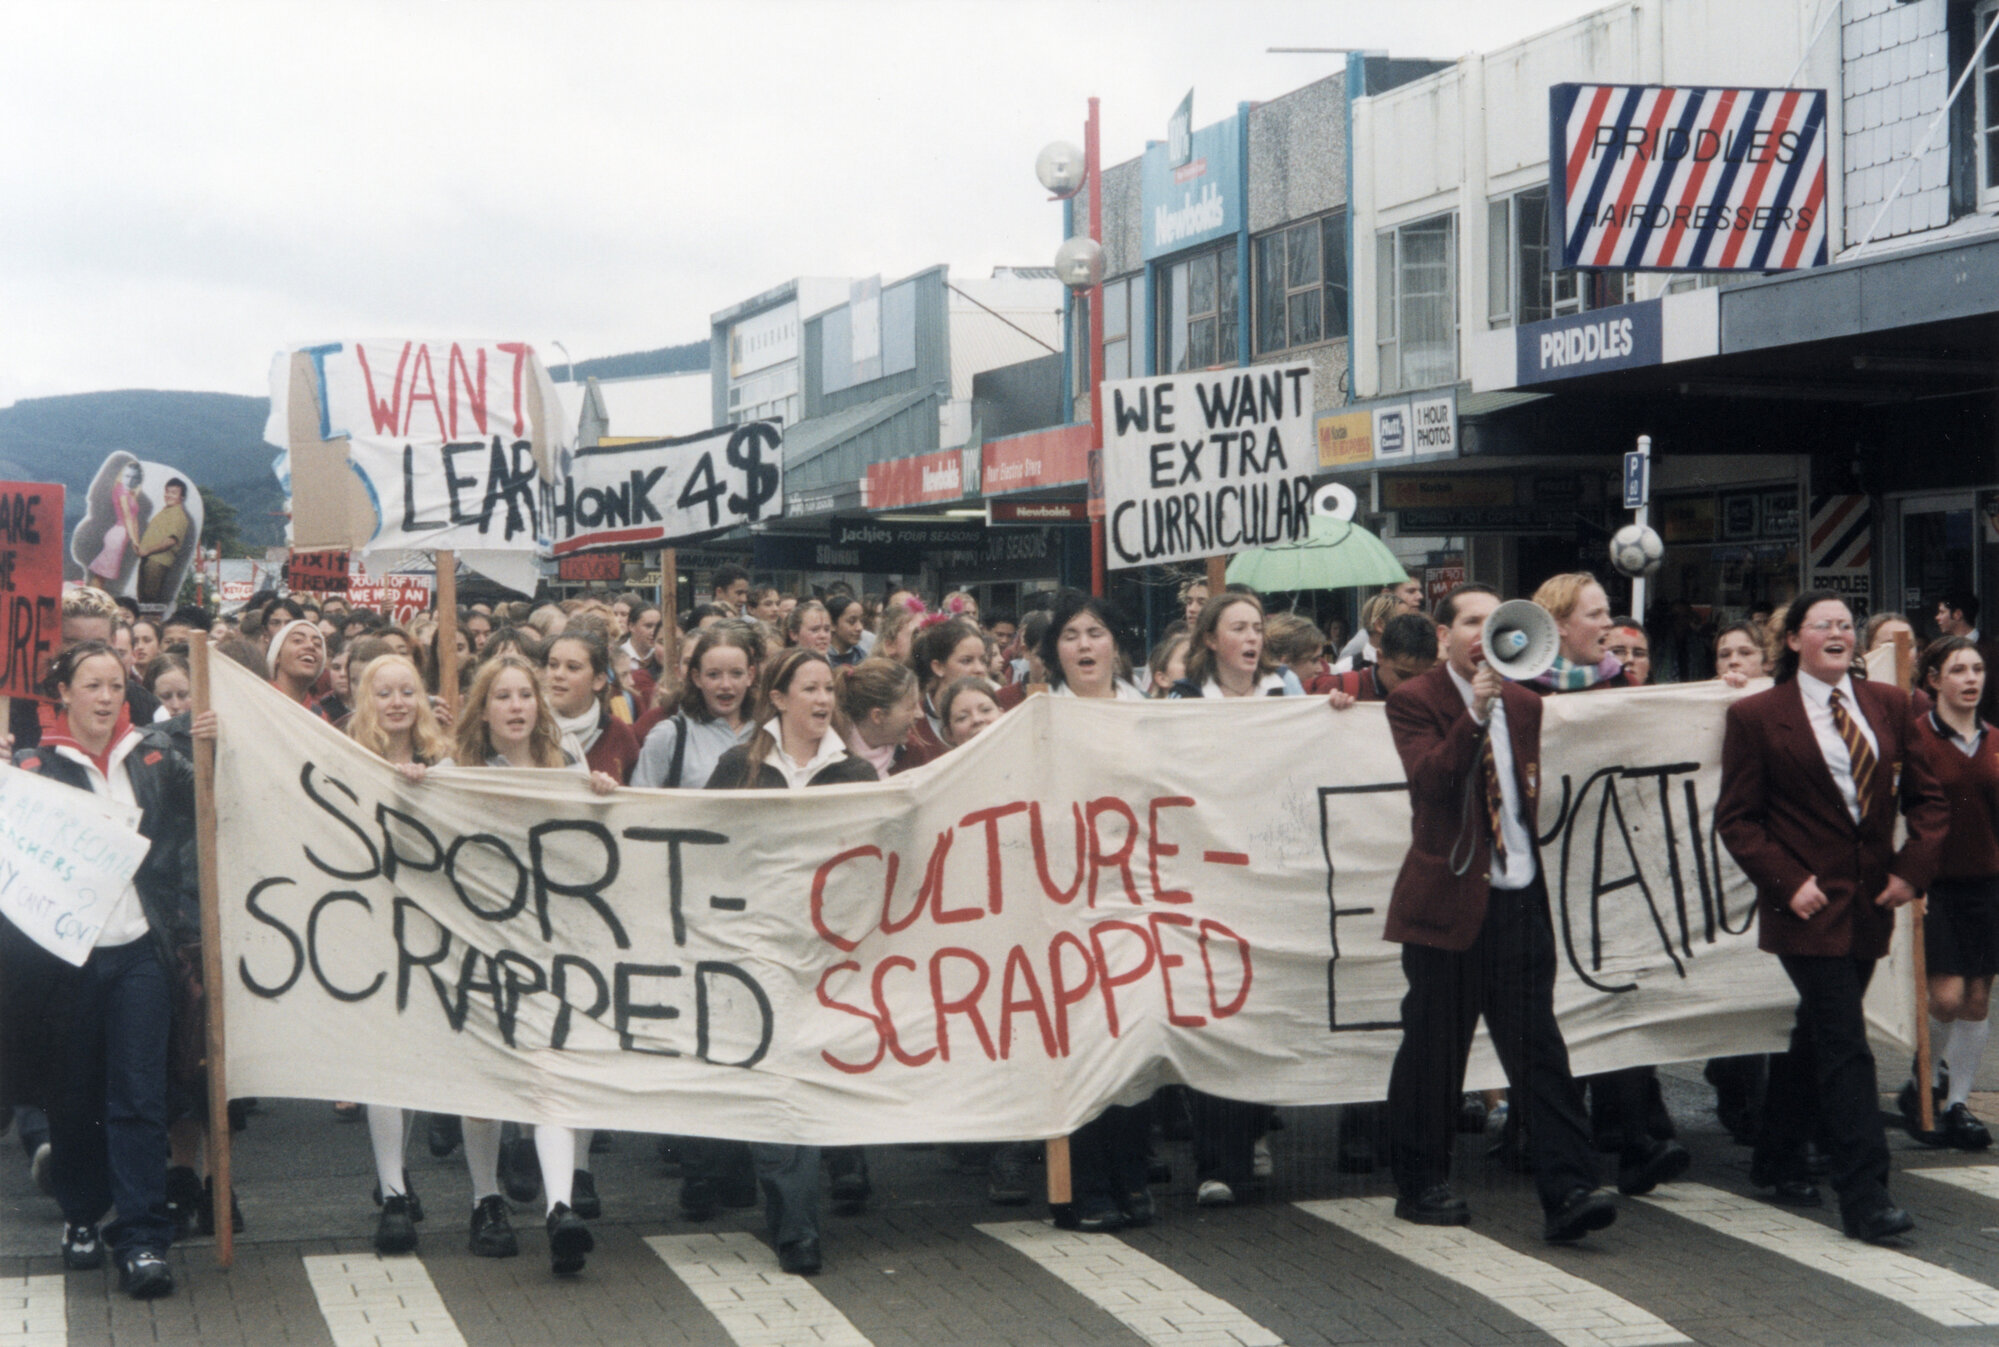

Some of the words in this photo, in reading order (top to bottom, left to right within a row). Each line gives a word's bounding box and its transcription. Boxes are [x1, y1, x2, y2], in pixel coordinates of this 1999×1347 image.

[1591, 126, 1801, 165] PRIDDLES
[1156, 182, 1224, 247] Newbolds
[1581, 204, 1814, 232] HAIRDRESSERS
[1540, 317, 1634, 370] PRIDDLES
[356, 340, 529, 443] WANT
[1114, 382, 1175, 437] WE
[1196, 367, 1310, 429] WANT
[1424, 404, 1449, 425] HOUR
[1151, 426, 1288, 489] EXTRA
[1417, 426, 1451, 447] PHOTOS
[922, 458, 960, 493] Newbolds
[1630, 455, 1639, 477] P
[552, 466, 667, 539] HONK
[1016, 505, 1071, 518] Newbolds
[1112, 475, 1311, 563] CURRICULAR
[897, 531, 926, 542] FOUR
[930, 531, 980, 542] SEASONS
[405, 588, 424, 603] AN
[239, 876, 773, 1068] SCRAPPED
[816, 912, 1252, 1074] SCRAPPED
